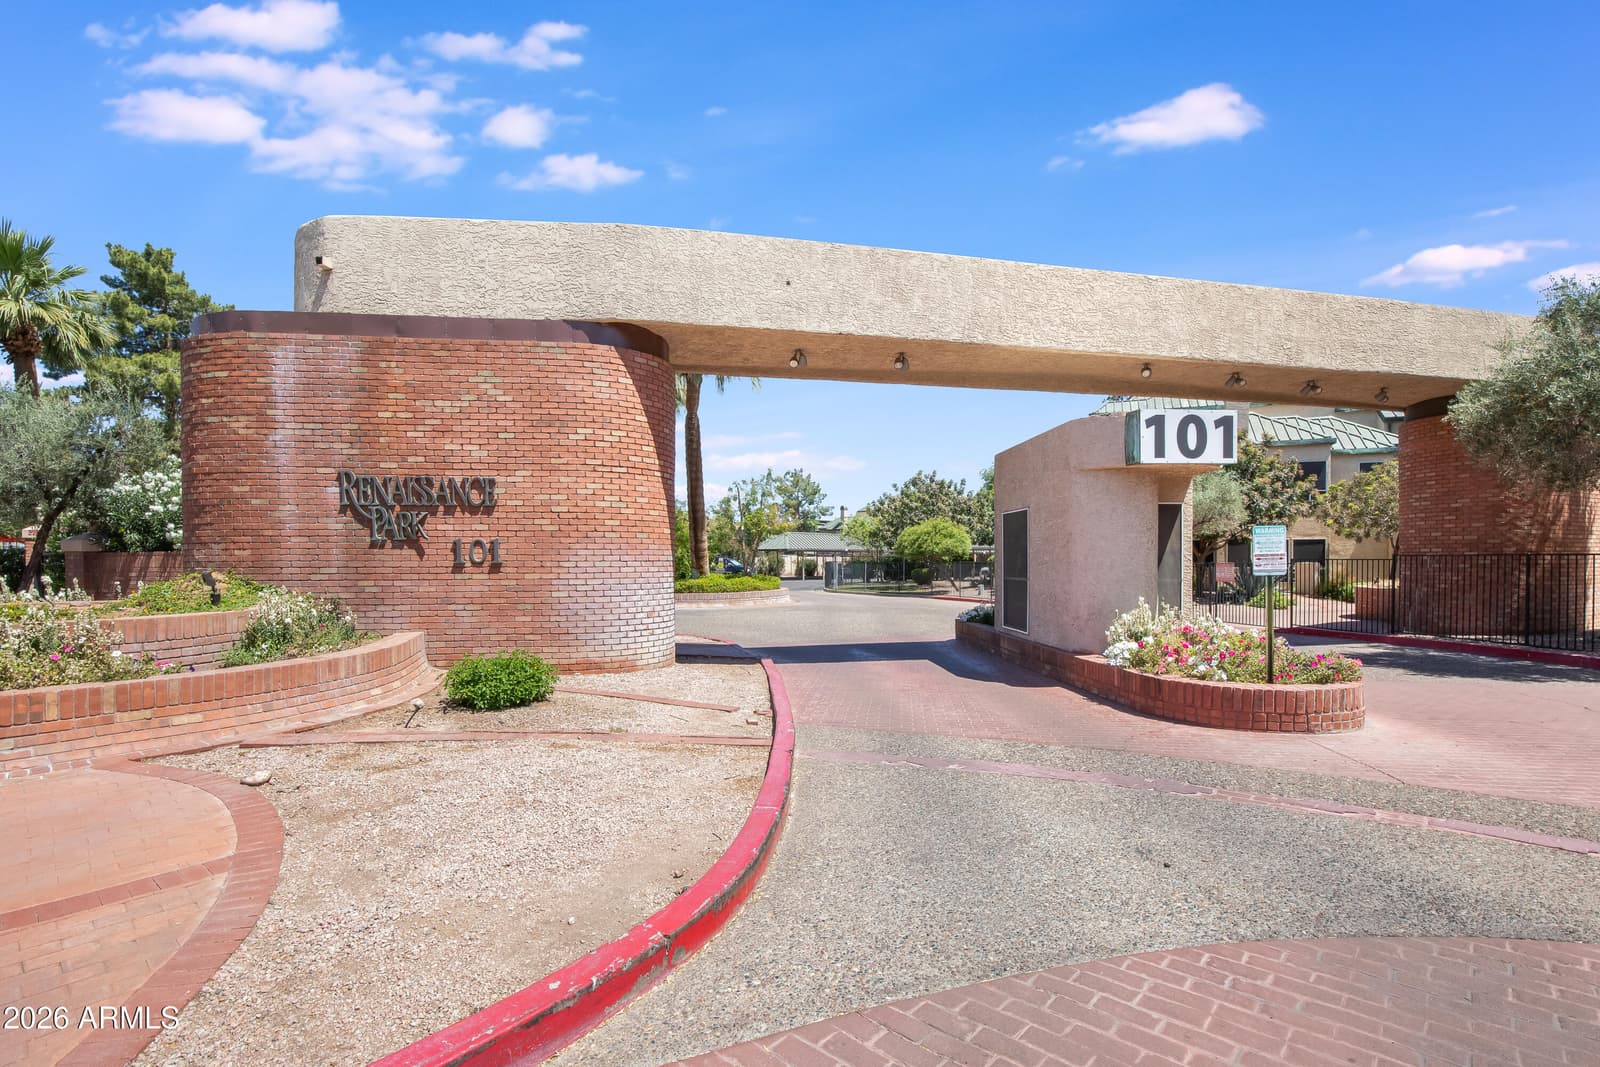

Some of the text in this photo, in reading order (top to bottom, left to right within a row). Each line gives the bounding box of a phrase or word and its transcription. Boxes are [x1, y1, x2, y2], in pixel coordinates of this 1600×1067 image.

[1144, 414, 1234, 459] 101
[340, 470, 497, 518] RENAISSANCE
[368, 505, 429, 541] PARK
[453, 537, 503, 565] 101
